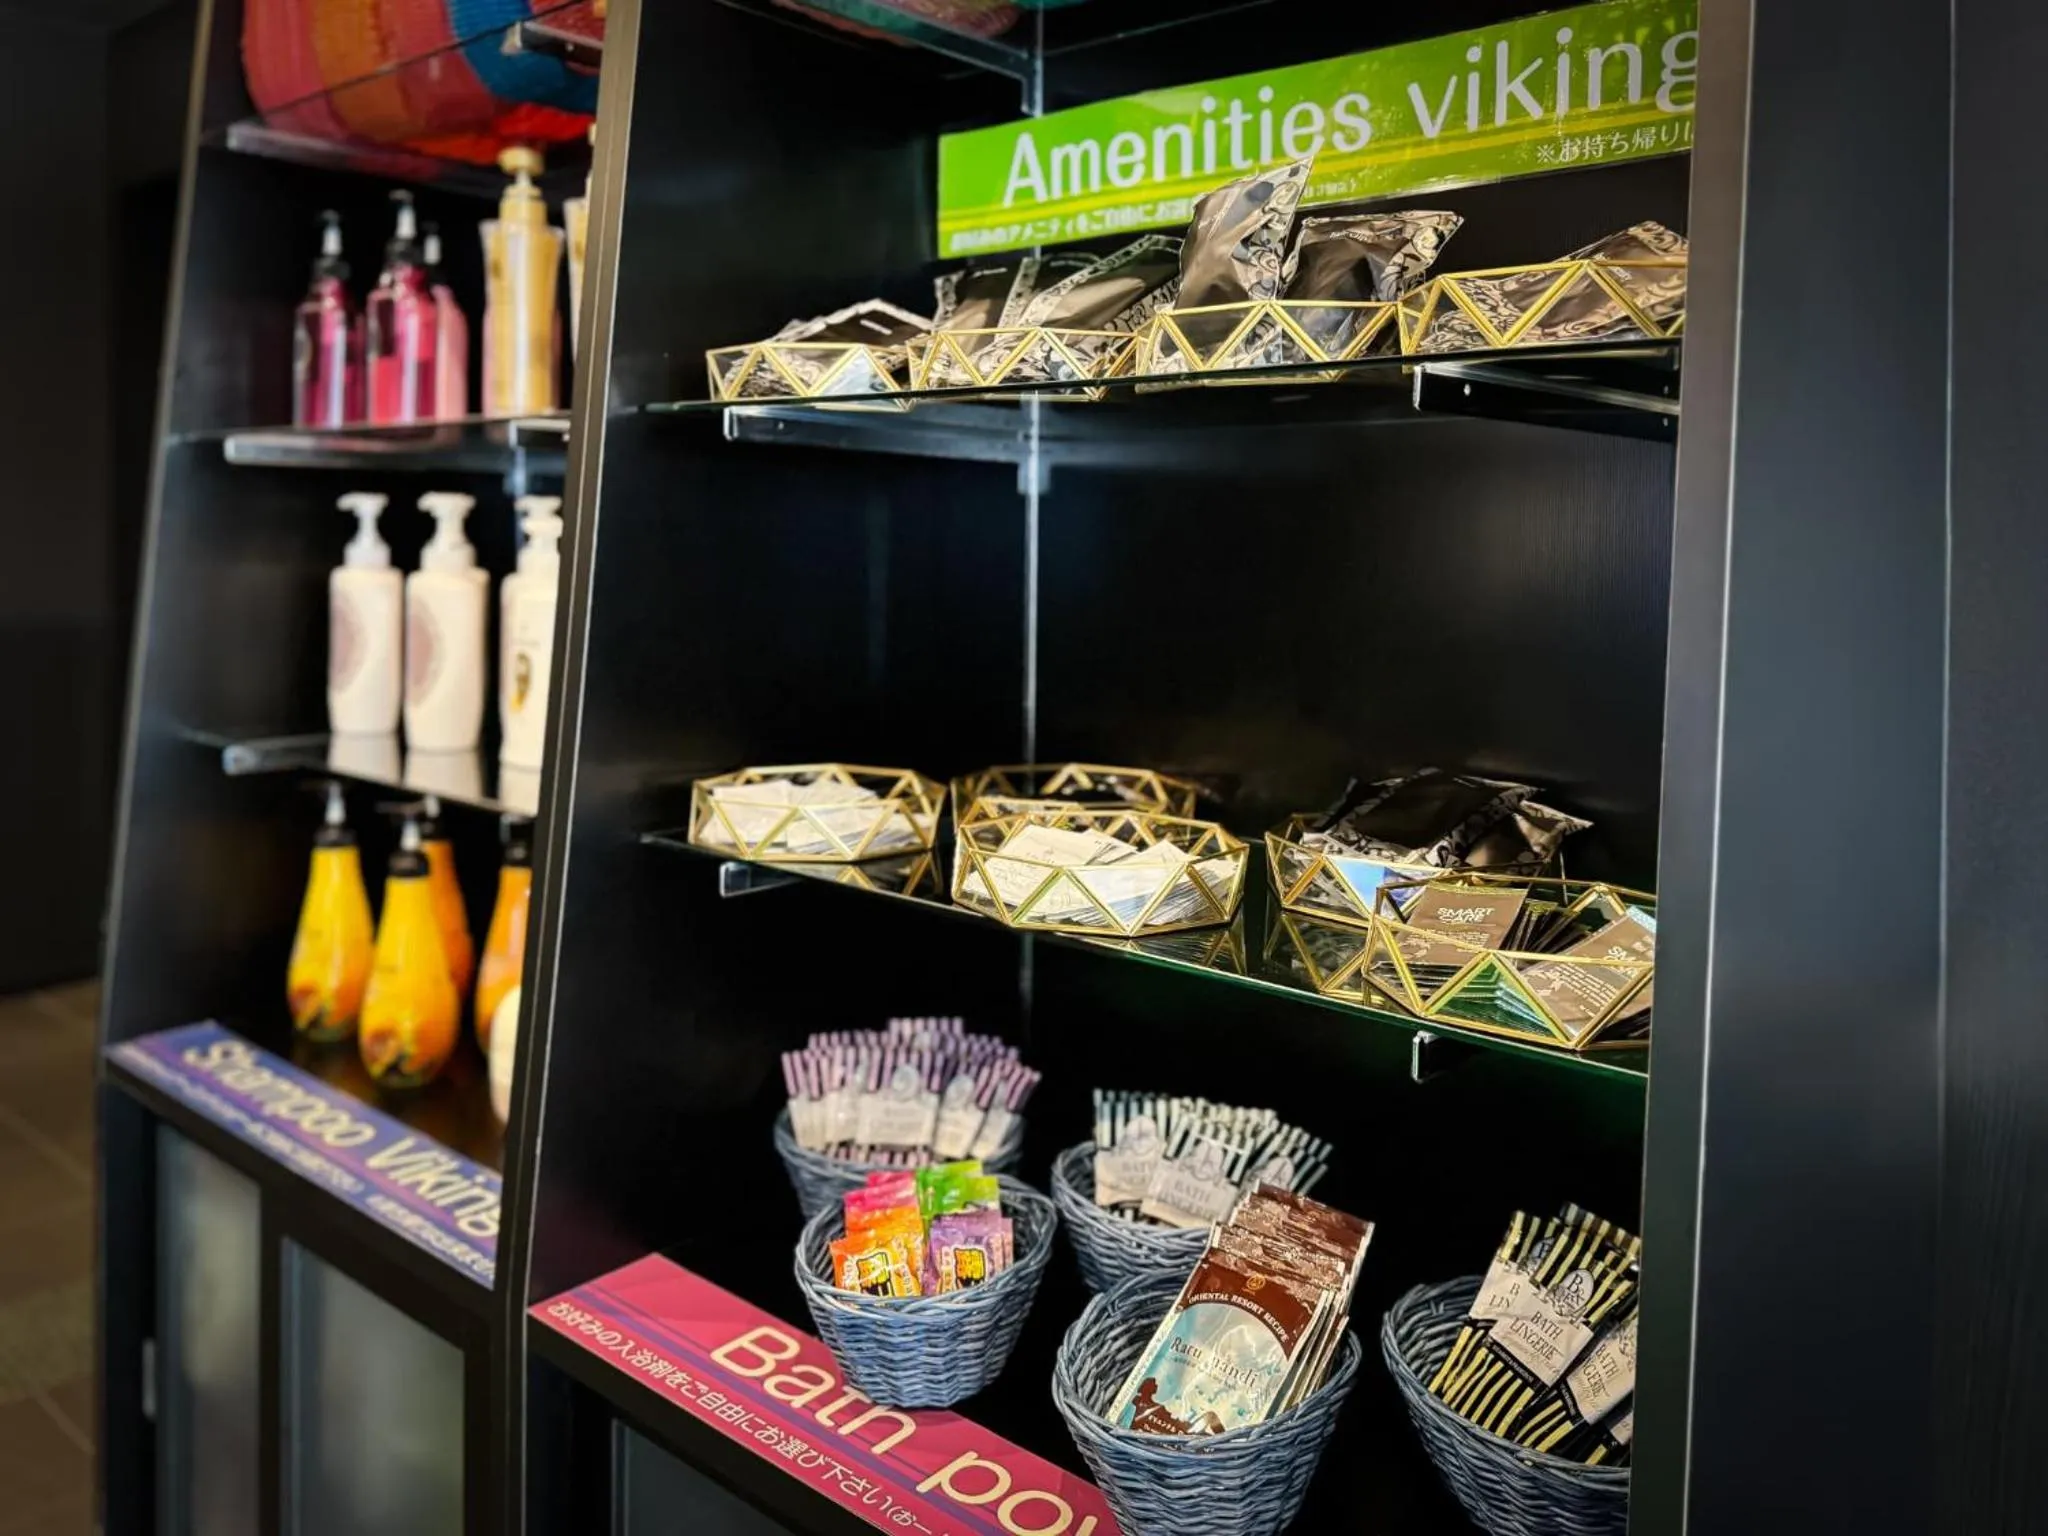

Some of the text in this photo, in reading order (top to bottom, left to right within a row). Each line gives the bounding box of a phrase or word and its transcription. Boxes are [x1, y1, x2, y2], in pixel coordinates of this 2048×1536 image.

[1002, 26, 1697, 208] Amenities viking
[1230, 1294, 1265, 1315] RESORT
[1264, 1312, 1291, 1343] RECIPE
[1509, 1317, 1560, 1362] LINGERIE
[1530, 1310, 1564, 1341] BATH
[915, 1450, 1099, 1536] po
